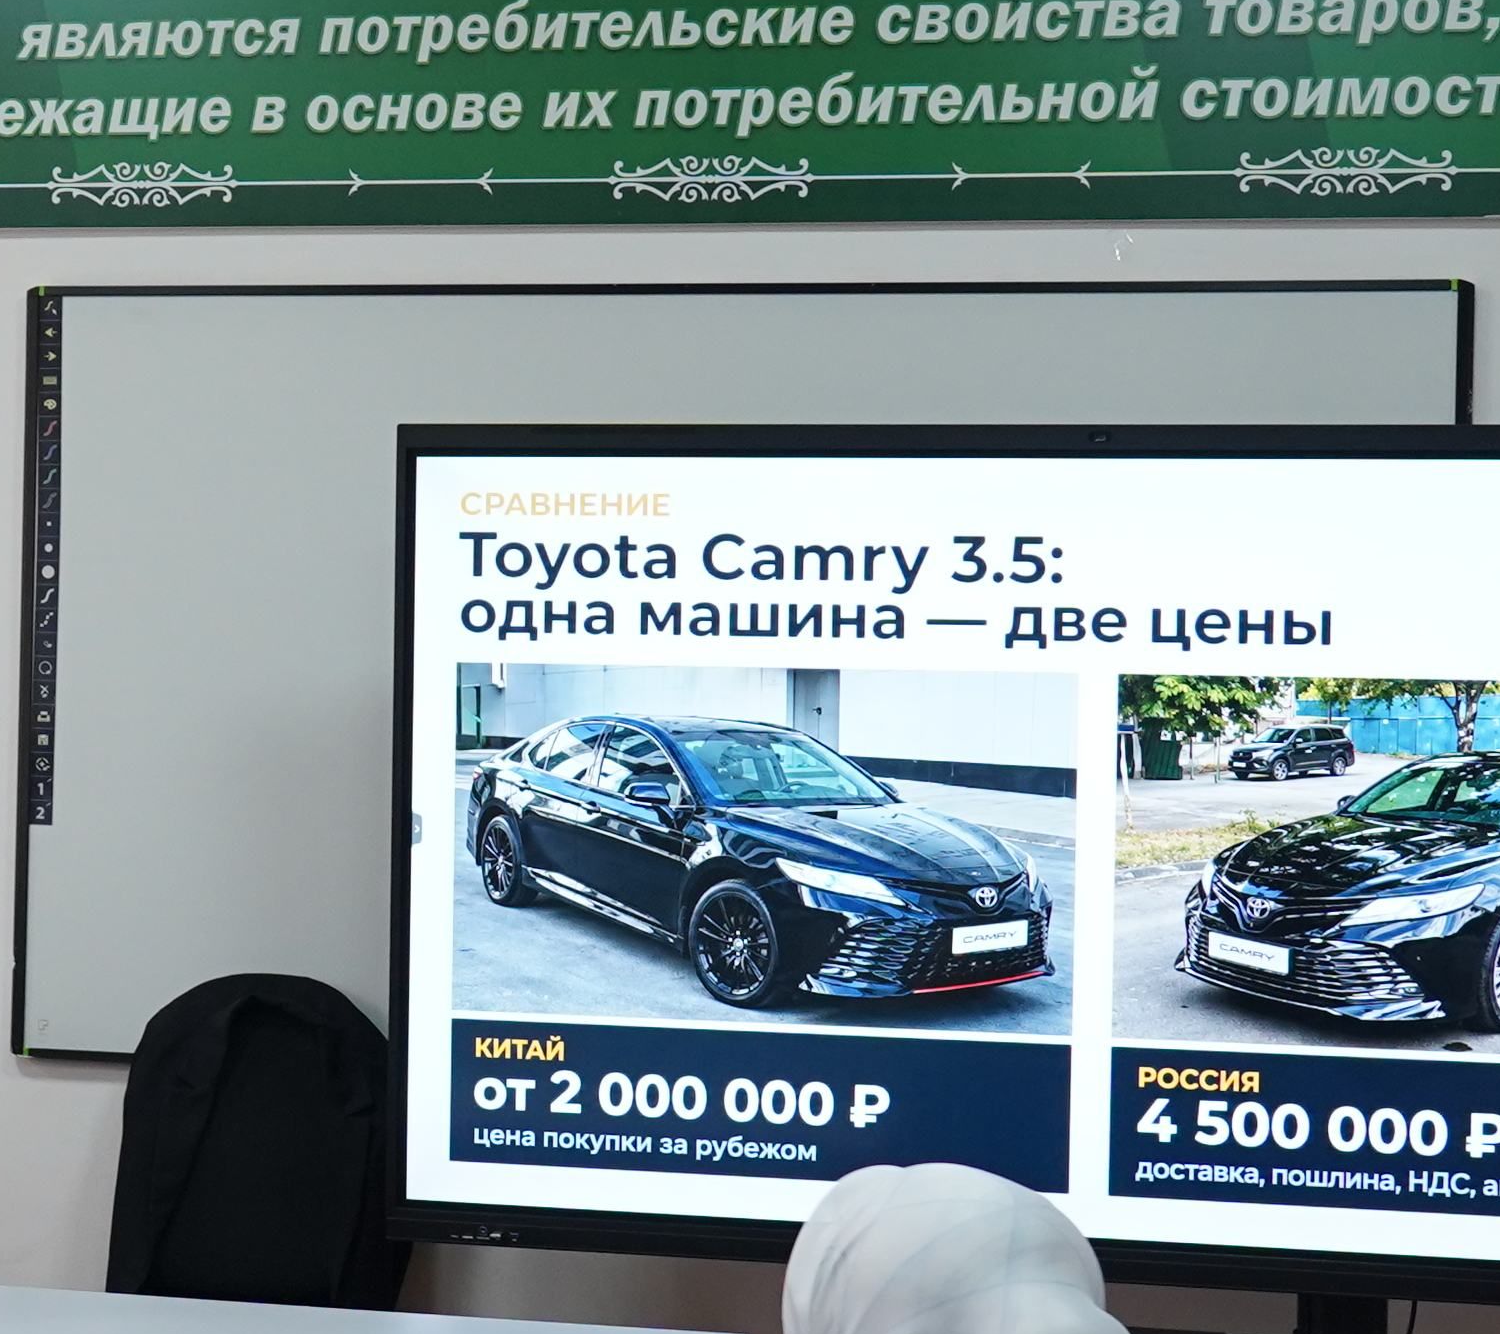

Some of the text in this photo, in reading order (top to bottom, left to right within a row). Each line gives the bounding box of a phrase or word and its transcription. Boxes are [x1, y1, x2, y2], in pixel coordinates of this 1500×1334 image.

[17, 18, 300, 59] являются
[251, 96, 286, 133] в
[306, 91, 522, 132] основе
[542, 90, 617, 128] их
[634, 76, 1159, 135] потребительной
[459, 492, 670, 518] СРАВНЕНИЕ
[458, 531, 1063, 595] Toyota Camry 3.5:
[460, 599, 615, 642] одна
[640, 601, 905, 640] машина
[1004, 606, 1128, 650] две
[1151, 608, 1332, 652] цены
[475, 1035, 565, 1062] КИТАЙ
[473, 1077, 536, 1112] от
[549, 1069, 582, 1114] 2
[598, 1071, 708, 1120] 000
[723, 1077, 835, 1127] 000
[1138, 1066, 1260, 1093] РОССИЯ
[473, 1127, 817, 1162] цена покупки за рубежом
[1136, 1097, 1178, 1143] 4
[1194, 1099, 1310, 1150] 500
[1327, 1105, 1448, 1157] 000
[1134, 1161, 1266, 1188] доставка,
[1271, 1167, 1402, 1195] пошлина,
[1408, 1170, 1477, 1199] НДС,
